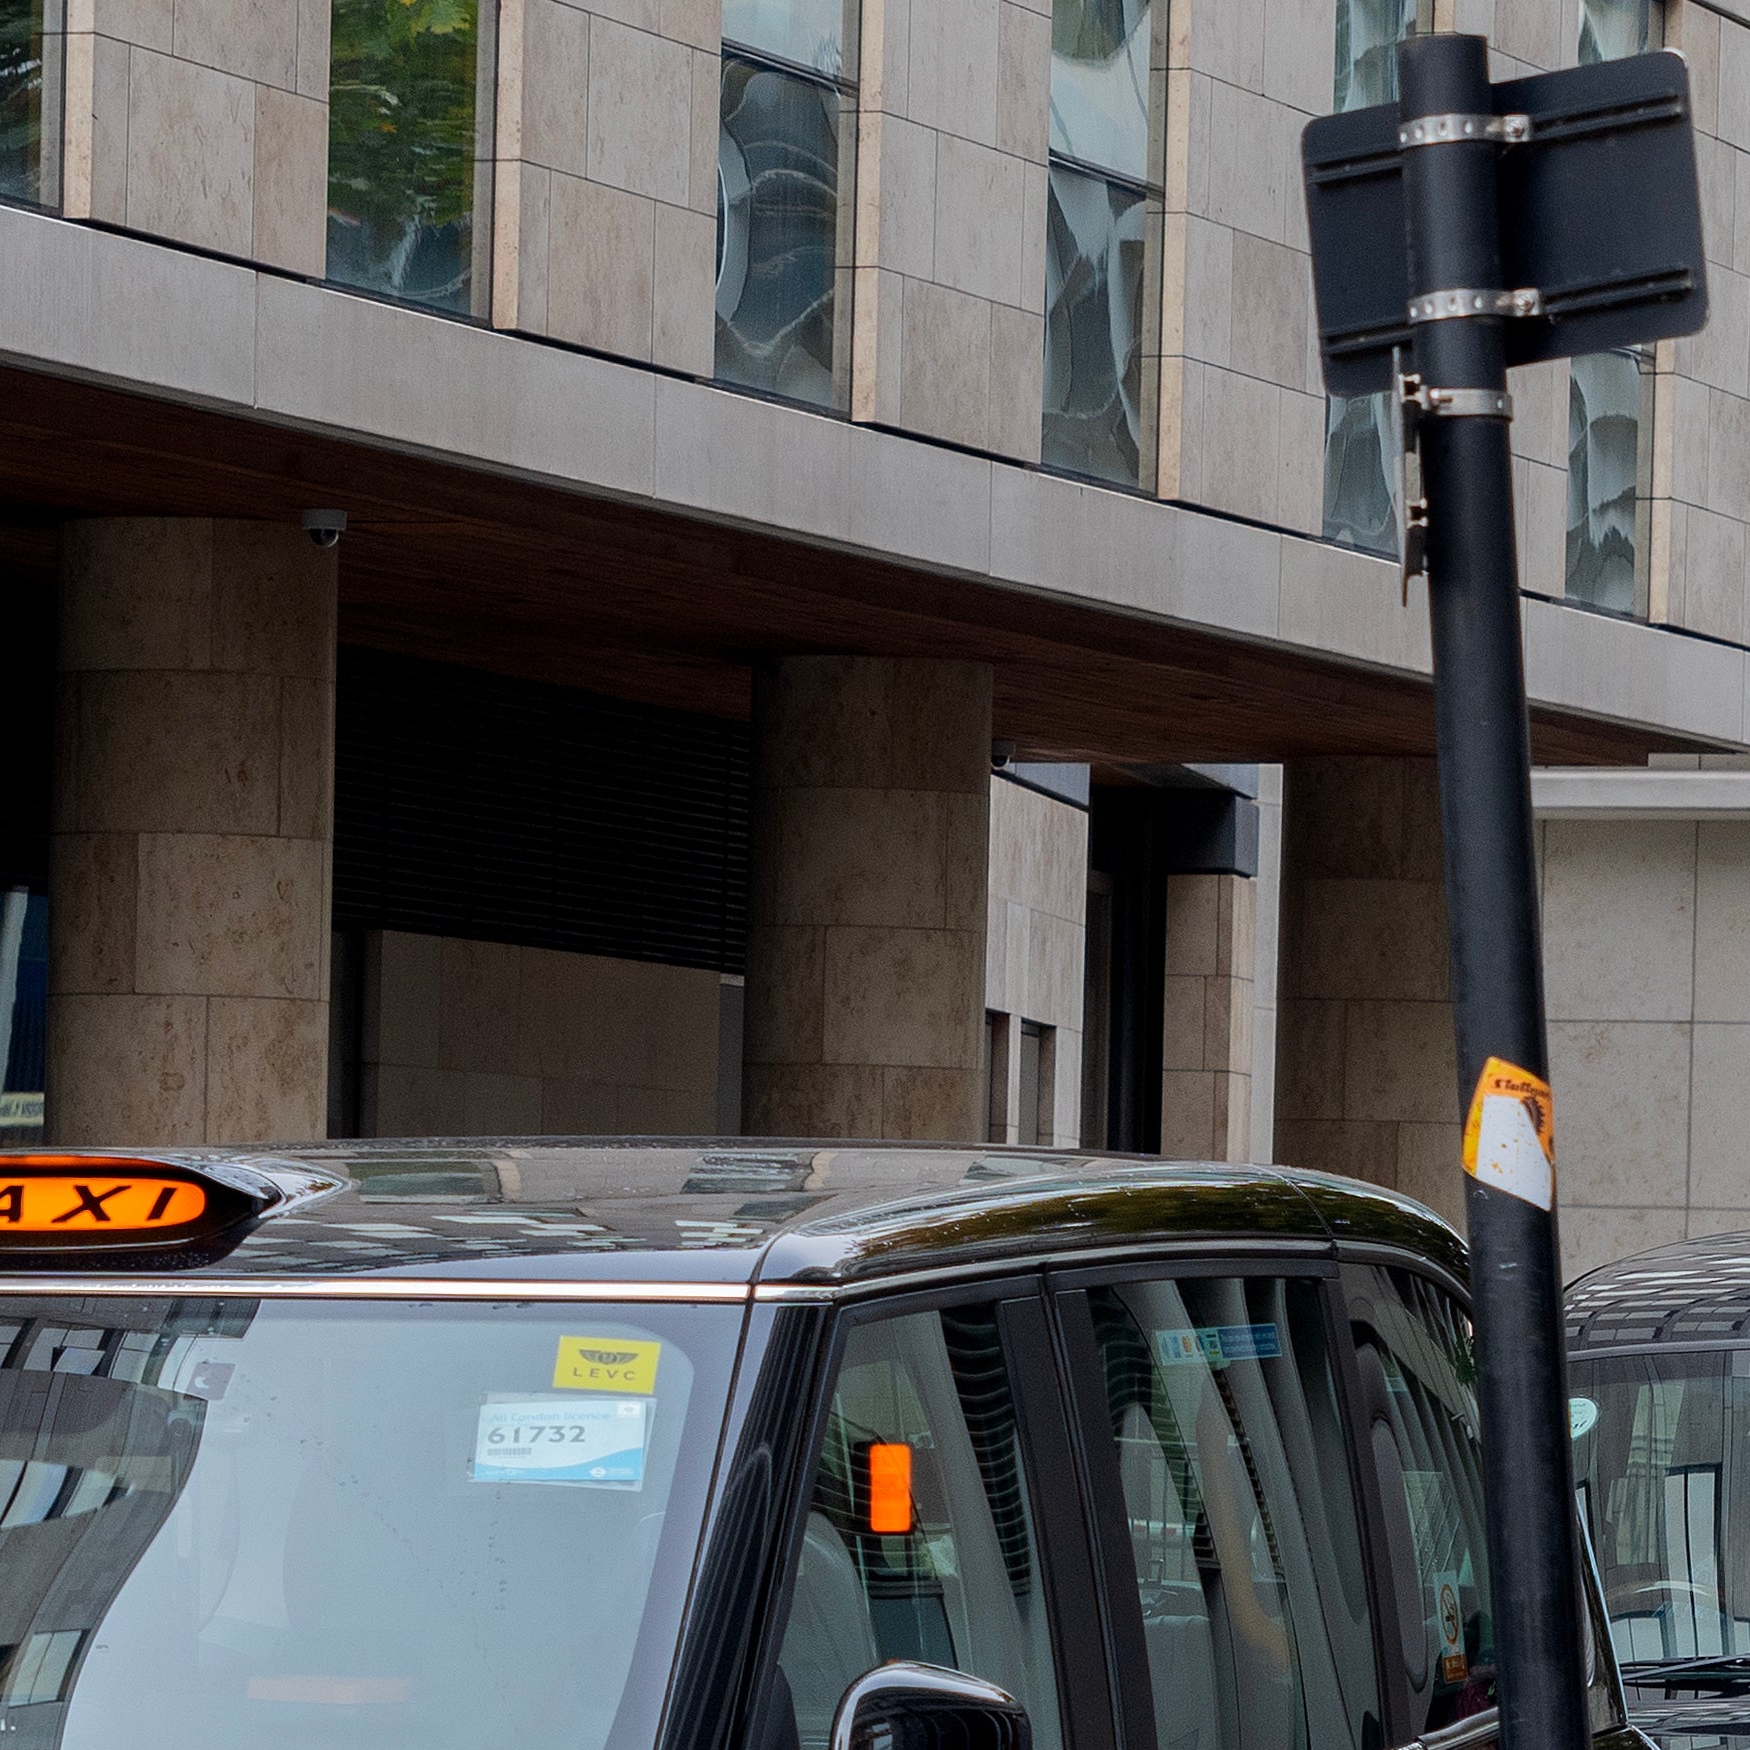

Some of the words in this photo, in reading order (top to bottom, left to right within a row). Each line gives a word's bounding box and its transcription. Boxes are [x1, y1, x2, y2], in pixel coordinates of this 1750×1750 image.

[572, 1367, 636, 1381] LEVC
[490, 1412, 507, 1422] All
[510, 1411, 561, 1422] London
[564, 1410, 610, 1421] licence
[487, 1425, 586, 1444] 61732
